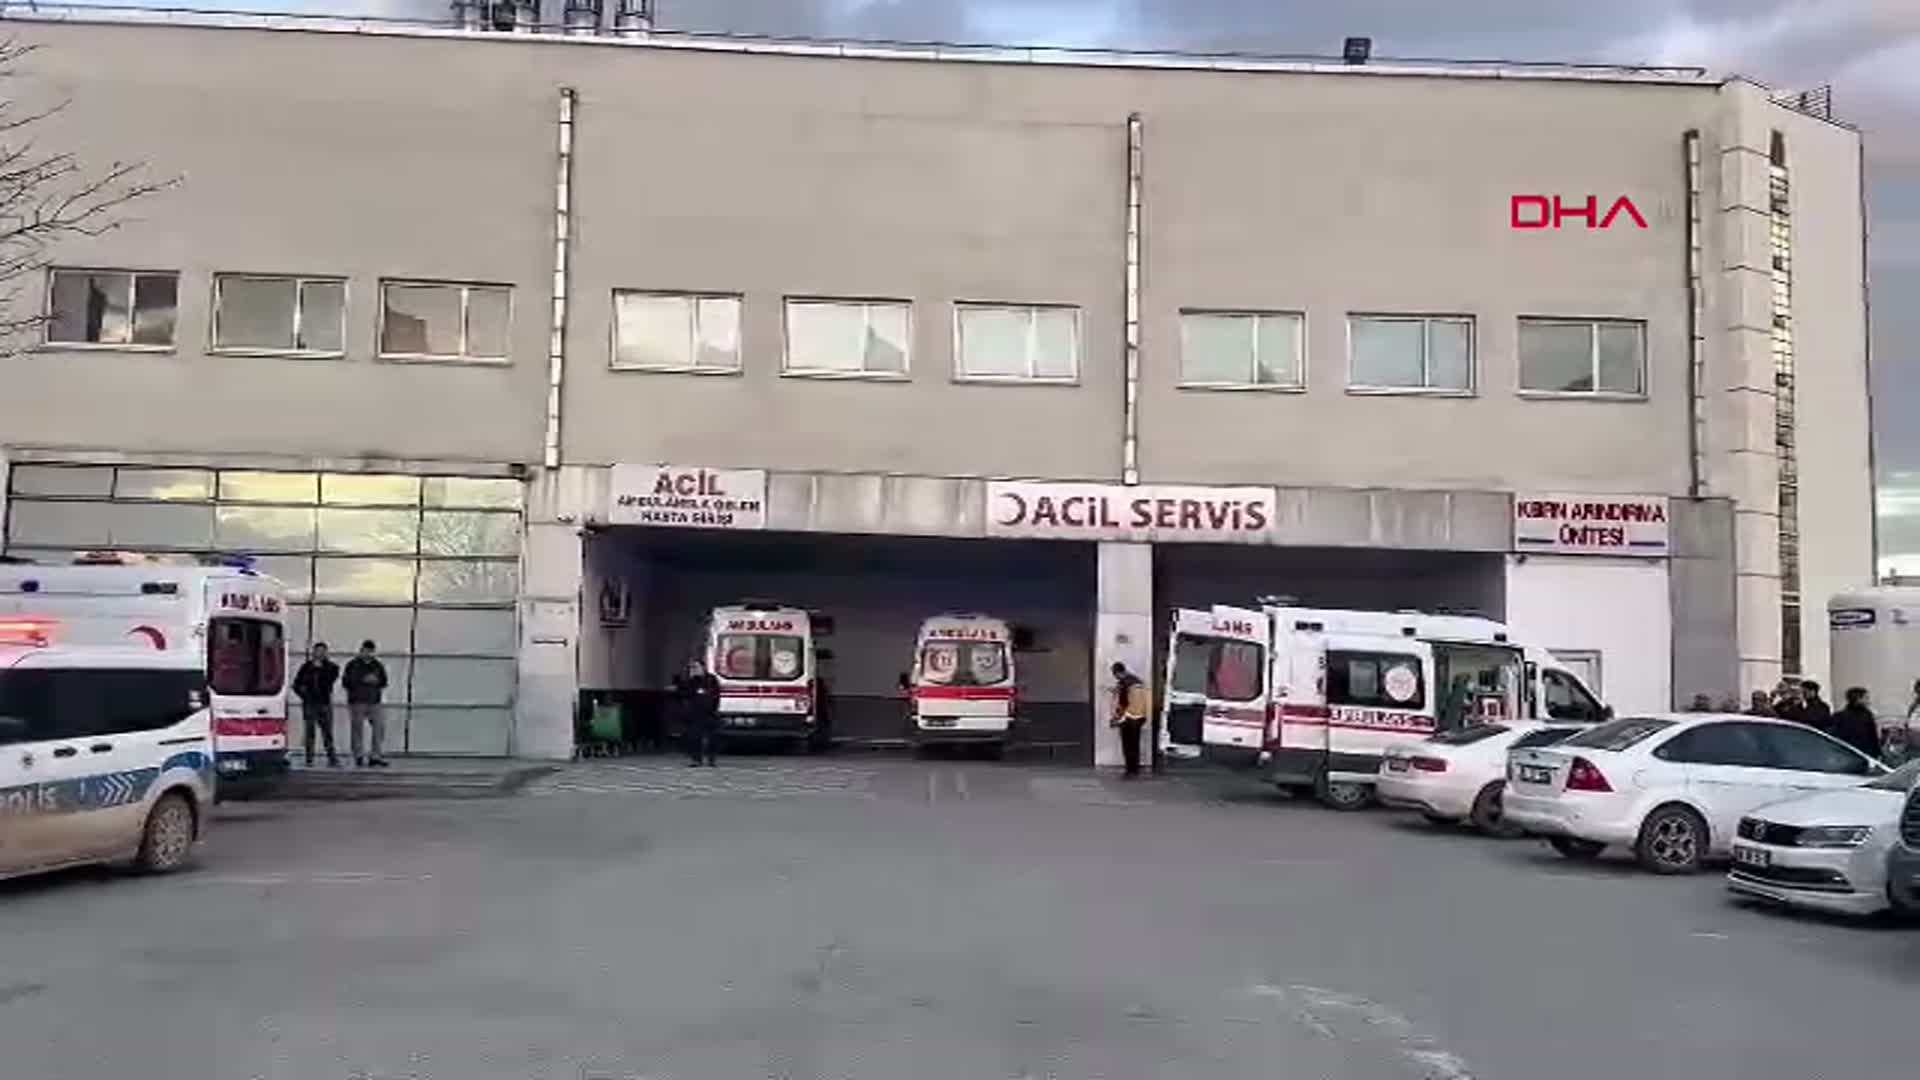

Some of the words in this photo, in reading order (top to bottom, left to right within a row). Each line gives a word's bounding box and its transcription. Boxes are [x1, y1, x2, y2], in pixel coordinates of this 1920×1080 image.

[653, 469, 726, 497] ACİL
[641, 511, 689, 523] HASTA
[1517, 500, 1567, 519] KBRN
[1571, 502, 1665, 523] ARINDIRMA
